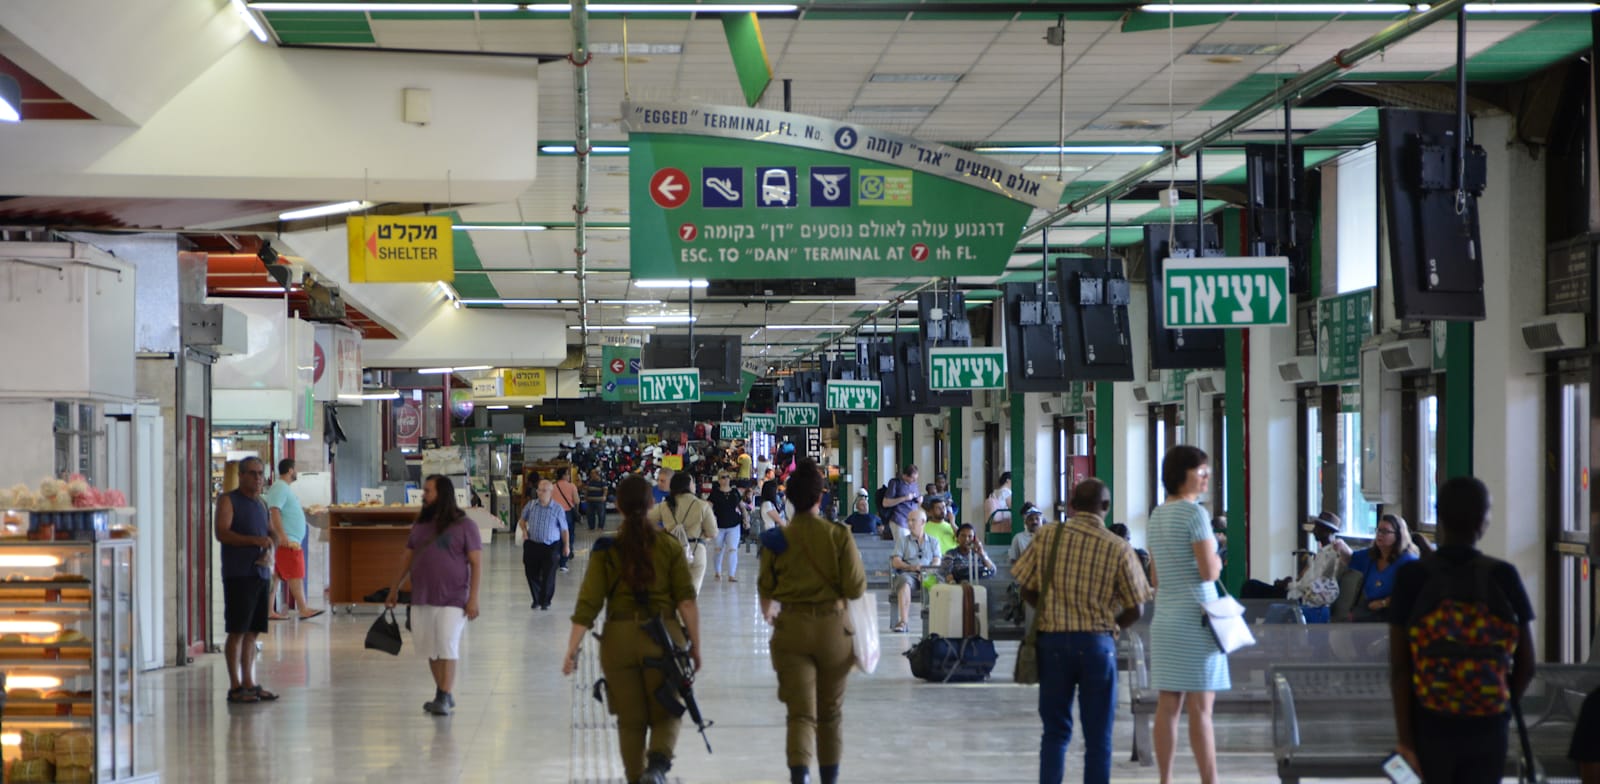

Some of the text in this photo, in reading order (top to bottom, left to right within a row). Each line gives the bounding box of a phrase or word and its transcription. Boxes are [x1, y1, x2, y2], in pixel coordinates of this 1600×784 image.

[635, 107, 698, 125] "EGGED"
[703, 112, 771, 133] TERMINAL
[778, 121, 797, 137] FL.
[804, 125, 824, 142] No.
[866, 136, 903, 159] קומה
[955, 157, 1002, 181] נוסעים
[1006, 173, 1041, 197] אולם
[378, 223, 437, 242] מקלט
[704, 224, 755, 243] בקומה
[800, 223, 853, 239] נוסעים
[859, 219, 906, 238] לאולם
[911, 219, 949, 238] עולה
[955, 222, 1005, 238] דרגנוע
[378, 247, 438, 260] SHELTER
[681, 248, 713, 263] ESC.
[718, 248, 740, 262] TO
[804, 246, 881, 261] TERMINAL
[886, 246, 904, 261] AT
[936, 245, 951, 260] th
[957, 246, 977, 260] FL.
[1170, 275, 1267, 323] יציאה
[934, 358, 992, 387] יציאה
[643, 376, 690, 400] יציאה
[829, 386, 872, 409] יציאה
[743, 416, 772, 433] יציאה
[779, 407, 813, 425] יציאה
[721, 425, 743, 438] ציאה
